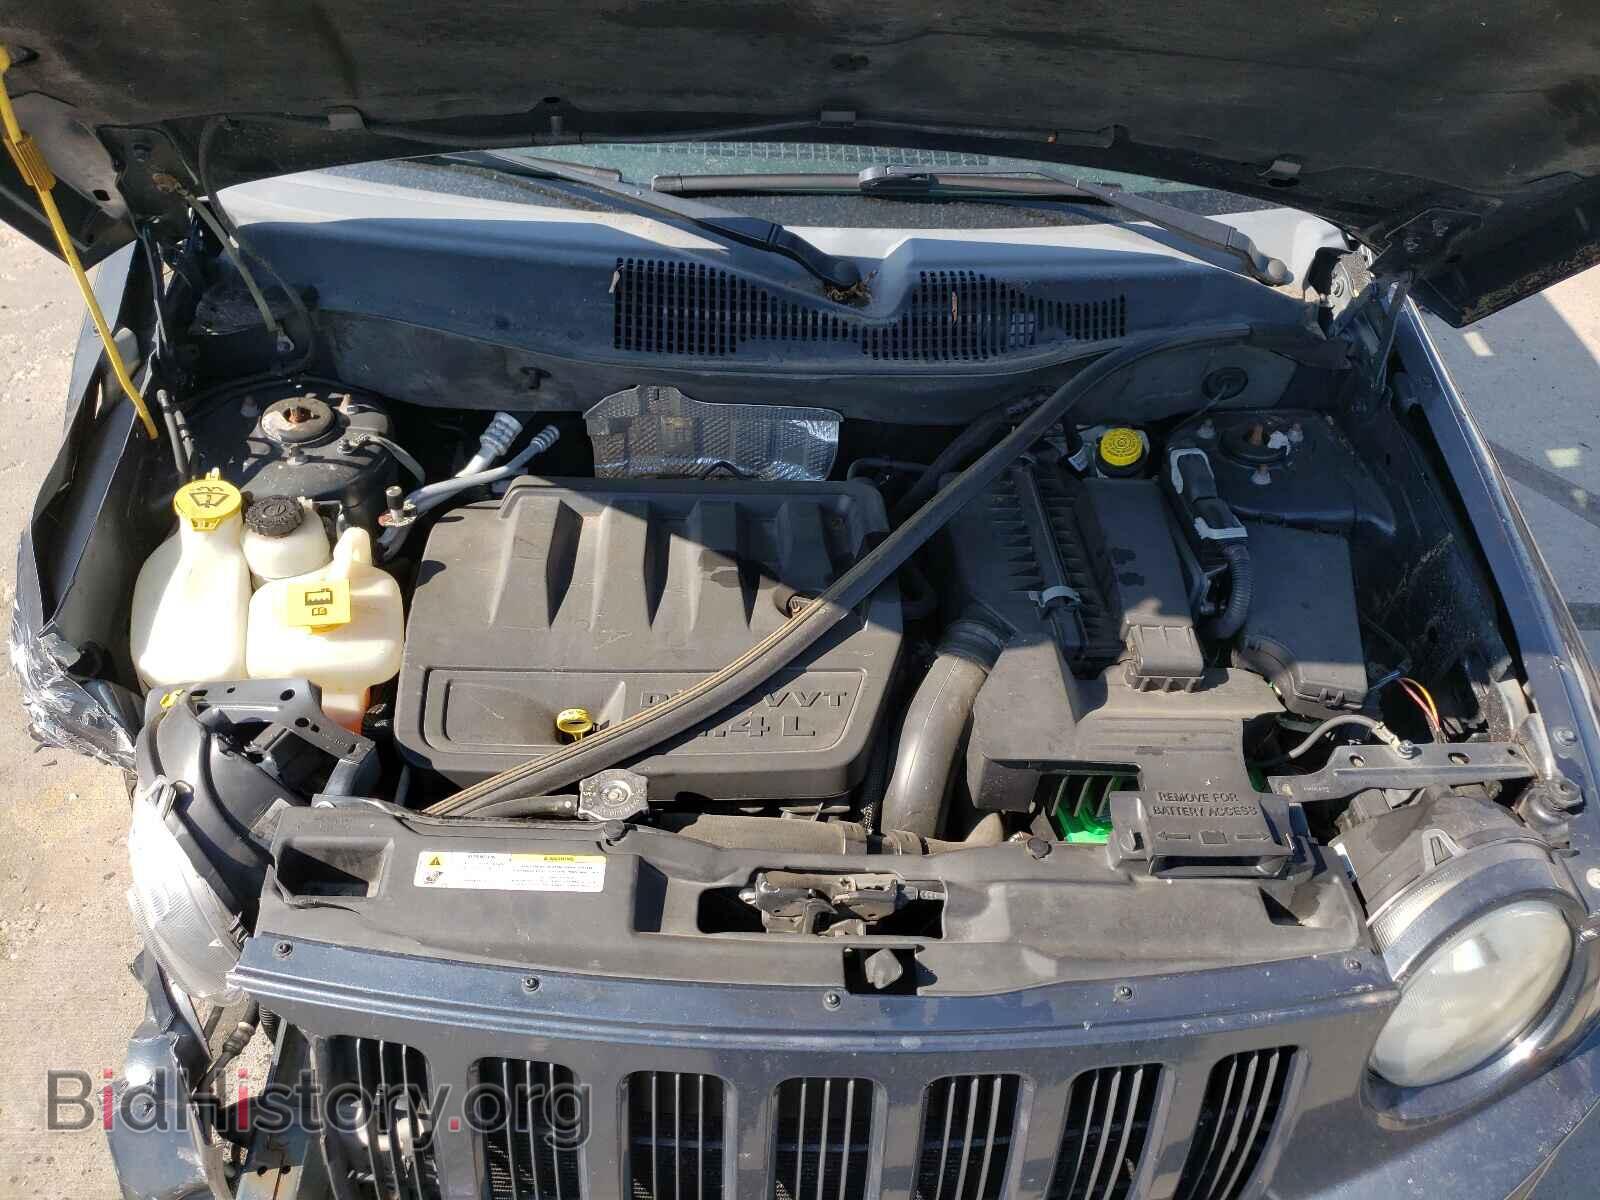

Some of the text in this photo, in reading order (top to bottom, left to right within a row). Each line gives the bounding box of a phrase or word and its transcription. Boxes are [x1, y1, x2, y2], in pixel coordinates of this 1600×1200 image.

[1158, 791, 1239, 802] REMOVE FOR
[1152, 805, 1258, 817] BATTERY ACCESS
